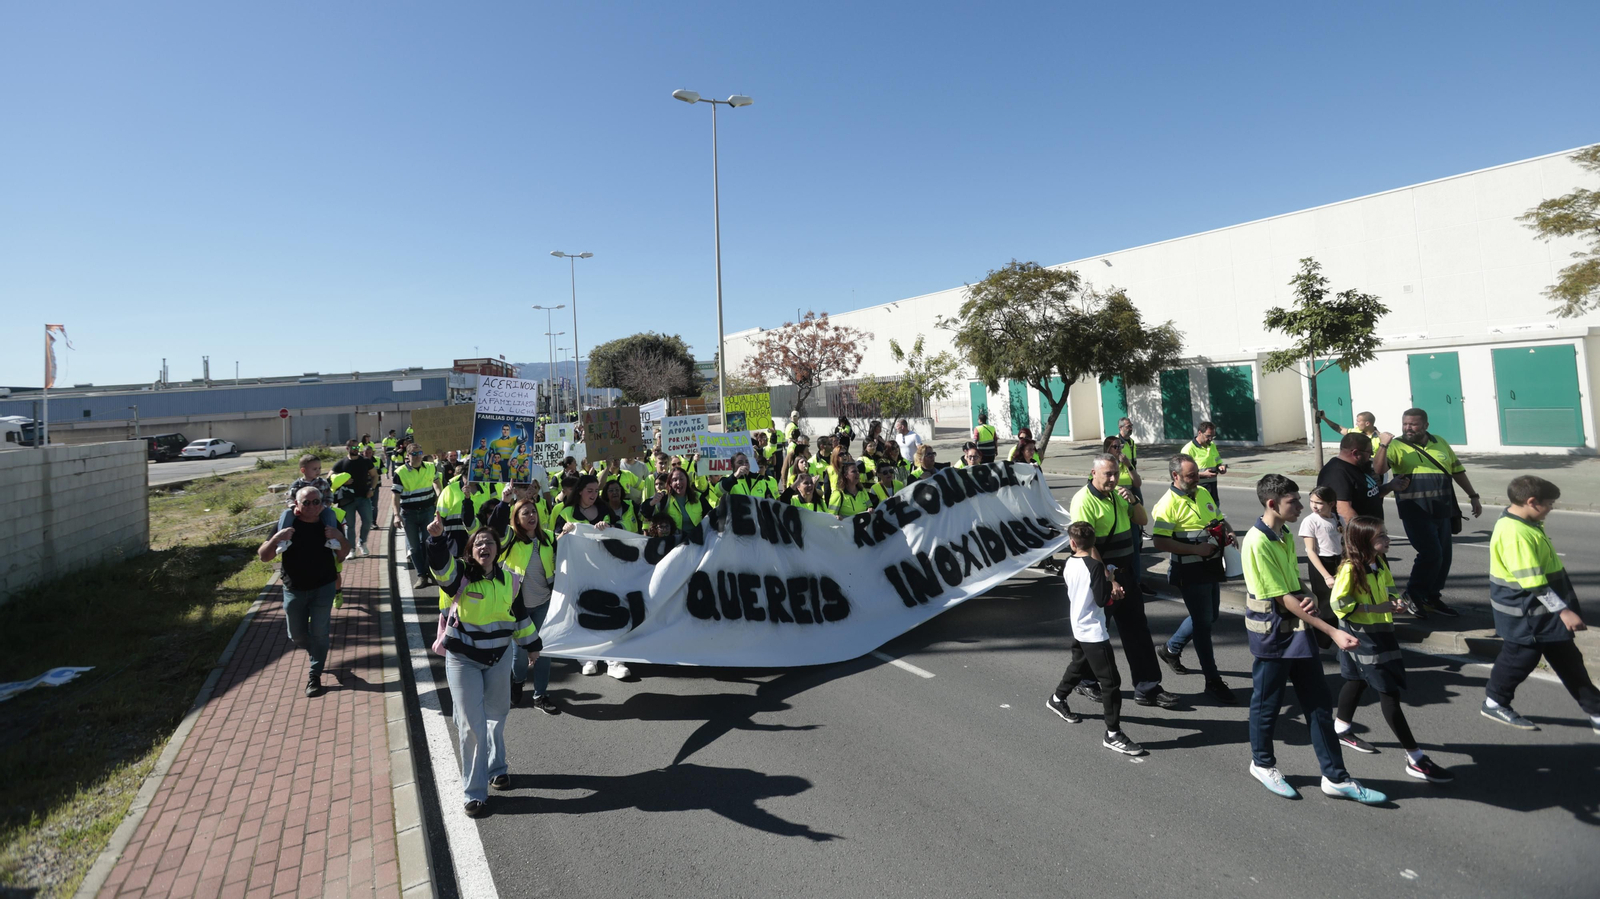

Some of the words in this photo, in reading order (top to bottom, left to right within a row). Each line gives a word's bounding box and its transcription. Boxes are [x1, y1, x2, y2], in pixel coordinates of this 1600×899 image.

[482, 376, 536, 390] ACERINOX
[486, 390, 528, 398] ESCUCHA
[489, 398, 524, 406] FAMILIA
[510, 406, 535, 414] LUCHA
[668, 418, 688, 427] PAPÁ
[748, 416, 770, 430] NO
[668, 424, 704, 434] APOYAMOS
[698, 434, 750, 447] FAMILIA
[544, 443, 558, 452] PASO
[700, 446, 716, 458] DE
[709, 459, 732, 470] UNI
[577, 588, 646, 632] SI
[686, 570, 851, 624] QUEREIS
[884, 516, 1061, 608] INOXIDABLE
